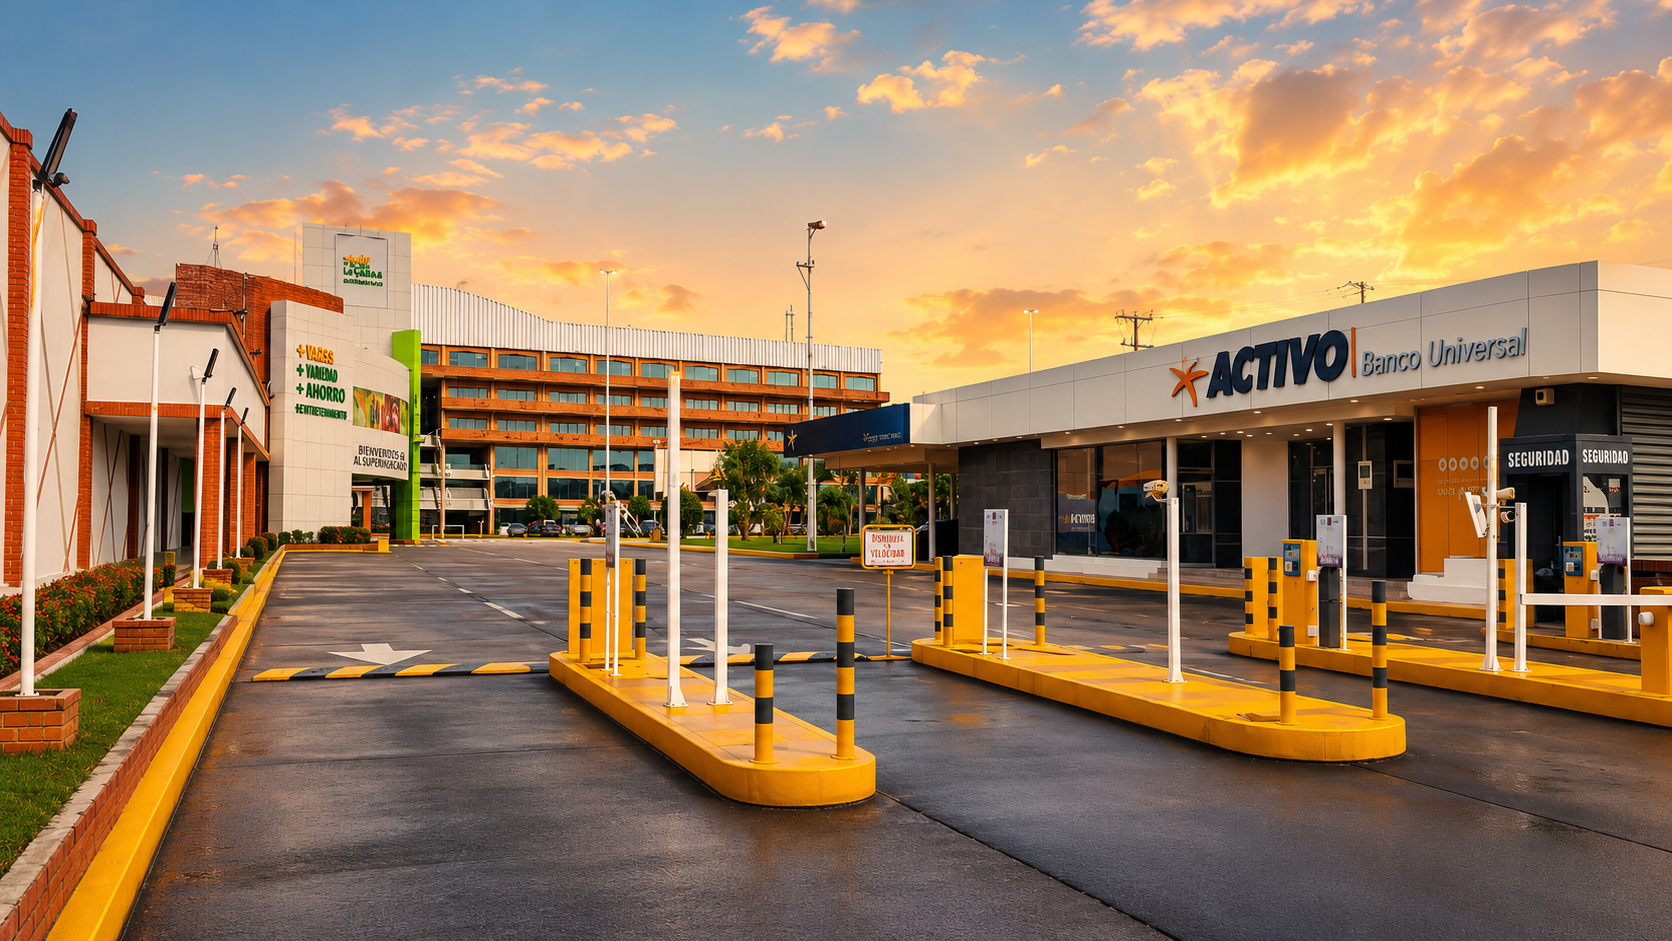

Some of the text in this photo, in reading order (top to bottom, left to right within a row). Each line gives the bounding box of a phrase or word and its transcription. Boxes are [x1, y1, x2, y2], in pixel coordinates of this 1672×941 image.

[1361, 327, 1527, 376] Banco Universal
[1206, 329, 1349, 398] ACTIVO
[305, 382, 346, 404] AHORRO
[1508, 449, 1570, 468] SEGURIDAD
[1582, 449, 1629, 464] SEGURIDAD
